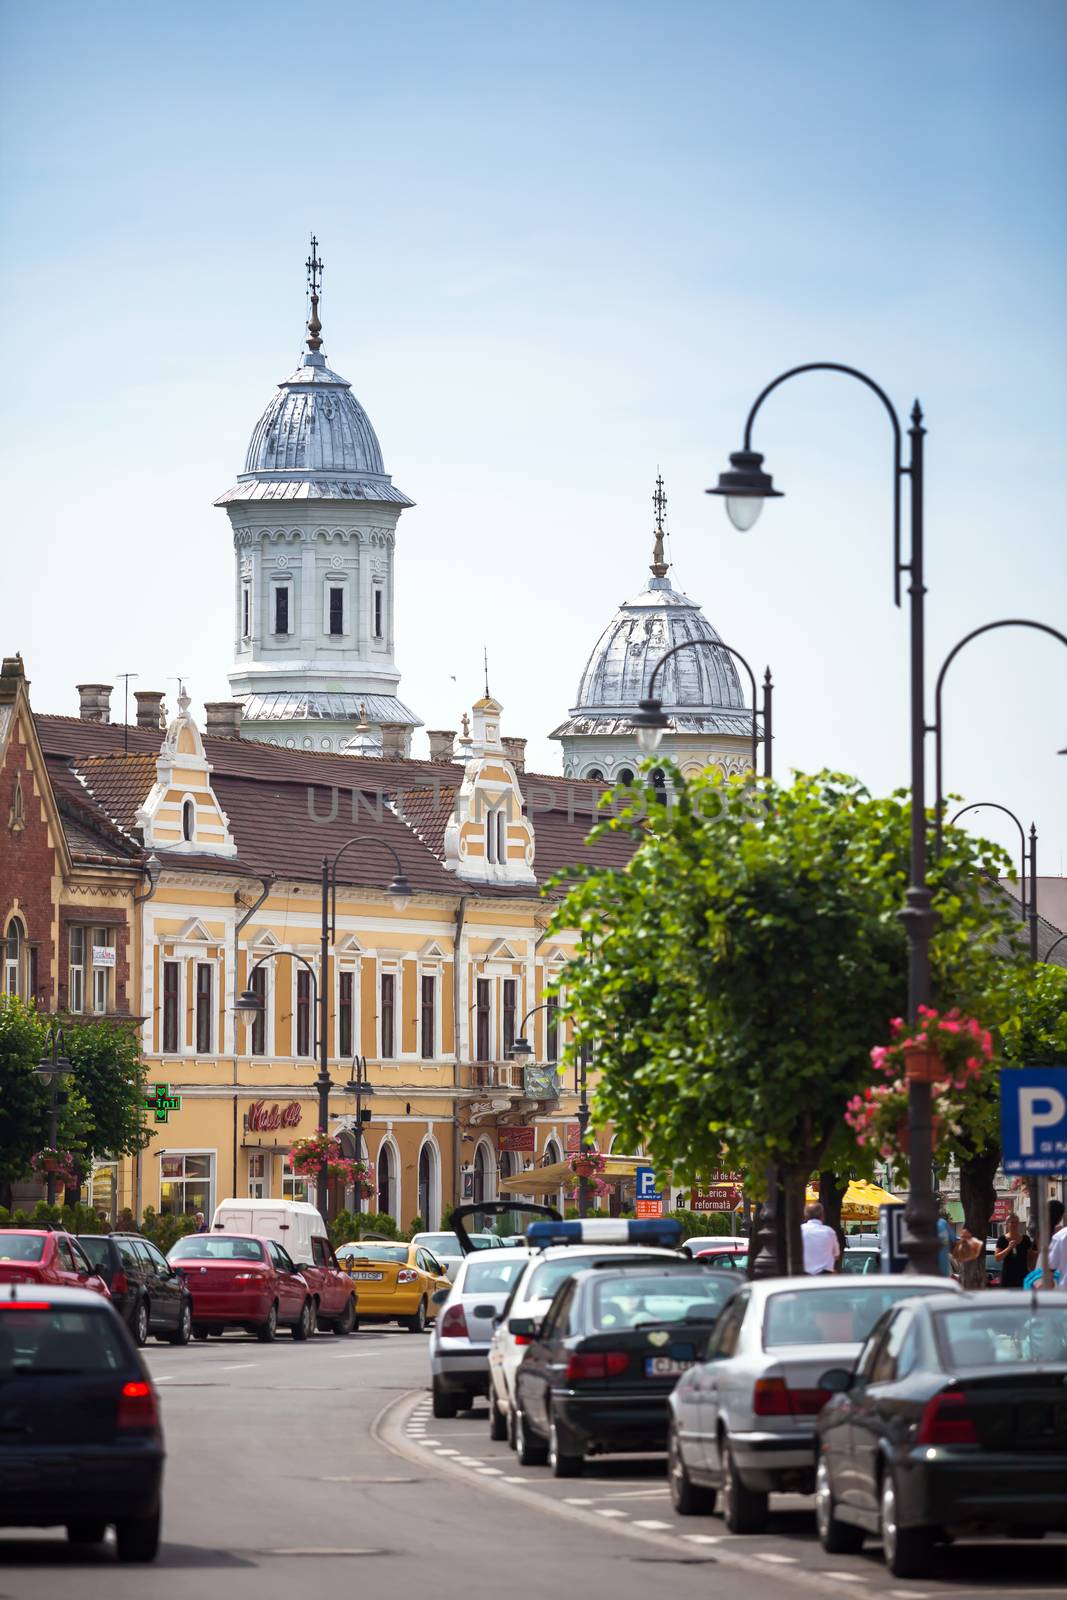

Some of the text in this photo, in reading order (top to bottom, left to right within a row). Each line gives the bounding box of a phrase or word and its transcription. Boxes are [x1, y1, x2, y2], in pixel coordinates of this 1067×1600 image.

[1018, 1086, 1066, 1155] P
[720, 1171, 728, 1180] de
[641, 1172, 657, 1195] P
[698, 1188, 727, 1198] Berica
[695, 1199, 731, 1209] reformată
